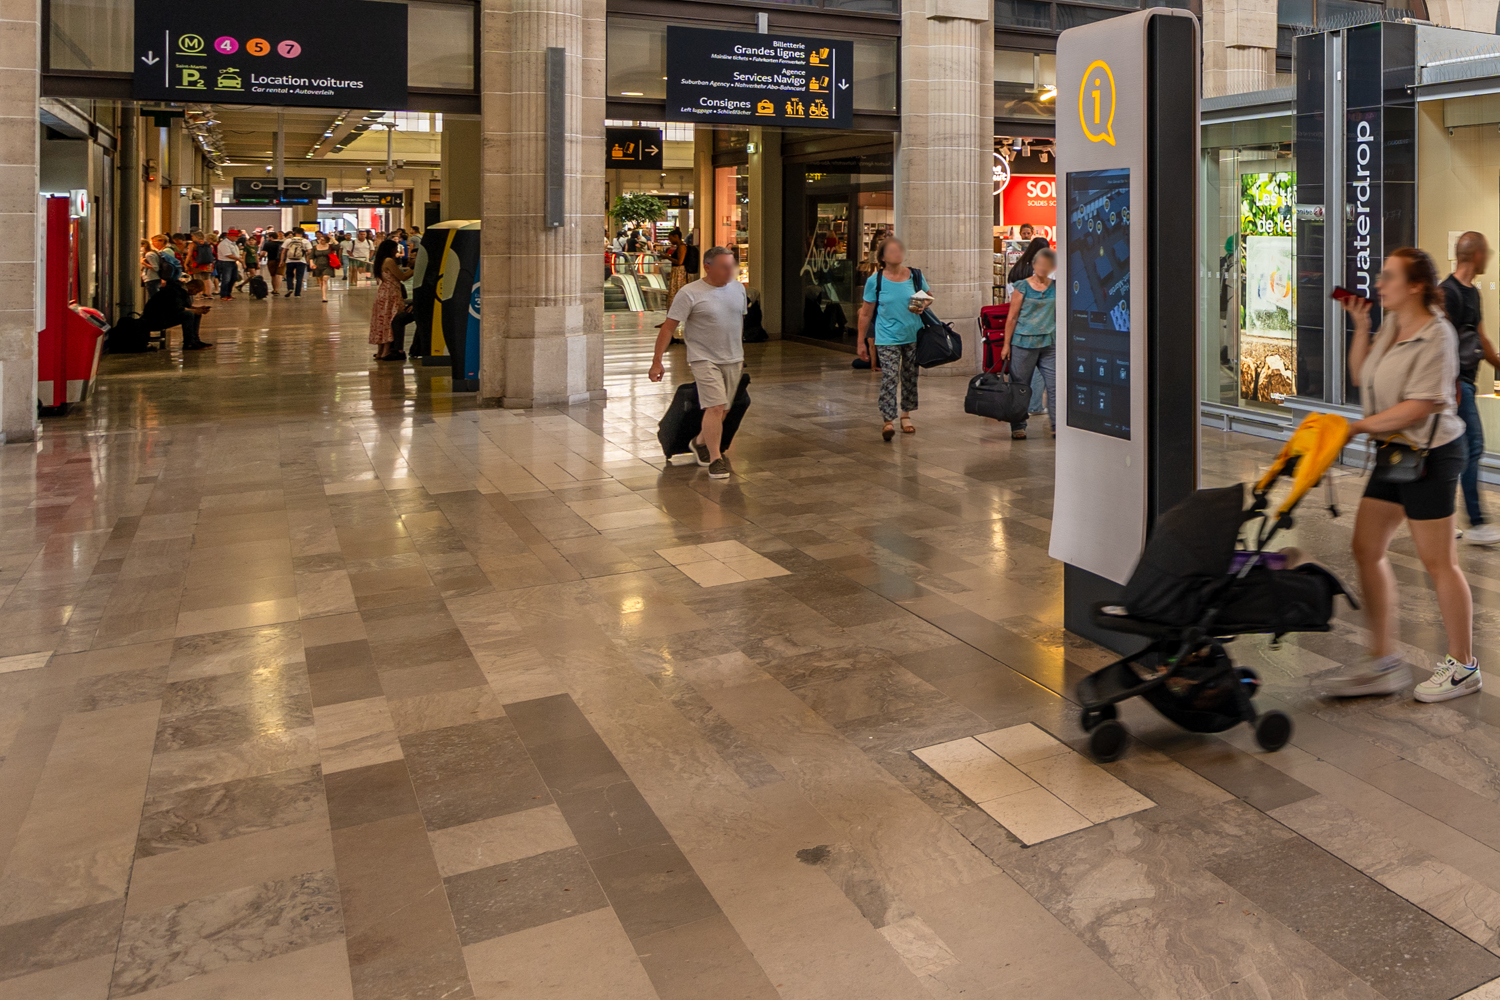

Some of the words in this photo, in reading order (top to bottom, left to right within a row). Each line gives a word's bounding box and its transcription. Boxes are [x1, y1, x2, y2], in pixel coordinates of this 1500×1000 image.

[734, 45, 775, 56] Grandes
[777, 48, 805, 59] lignes
[773, 41, 806, 50] Billetterie
[781, 68, 806, 76] Agence
[251, 73, 309, 86] Location
[311, 77, 364, 89] voitures
[681, 78, 709, 86] Suburban
[709, 80, 730, 88] Agency
[733, 72, 772, 83] Services
[774, 74, 806, 87] Navigo
[294, 88, 335, 96] Autoverleih
[699, 96, 752, 110] Consignes
[1255, 189, 1278, 207] Les
[1352, 120, 1375, 300] waterdrop
[1258, 214, 1274, 233] de
